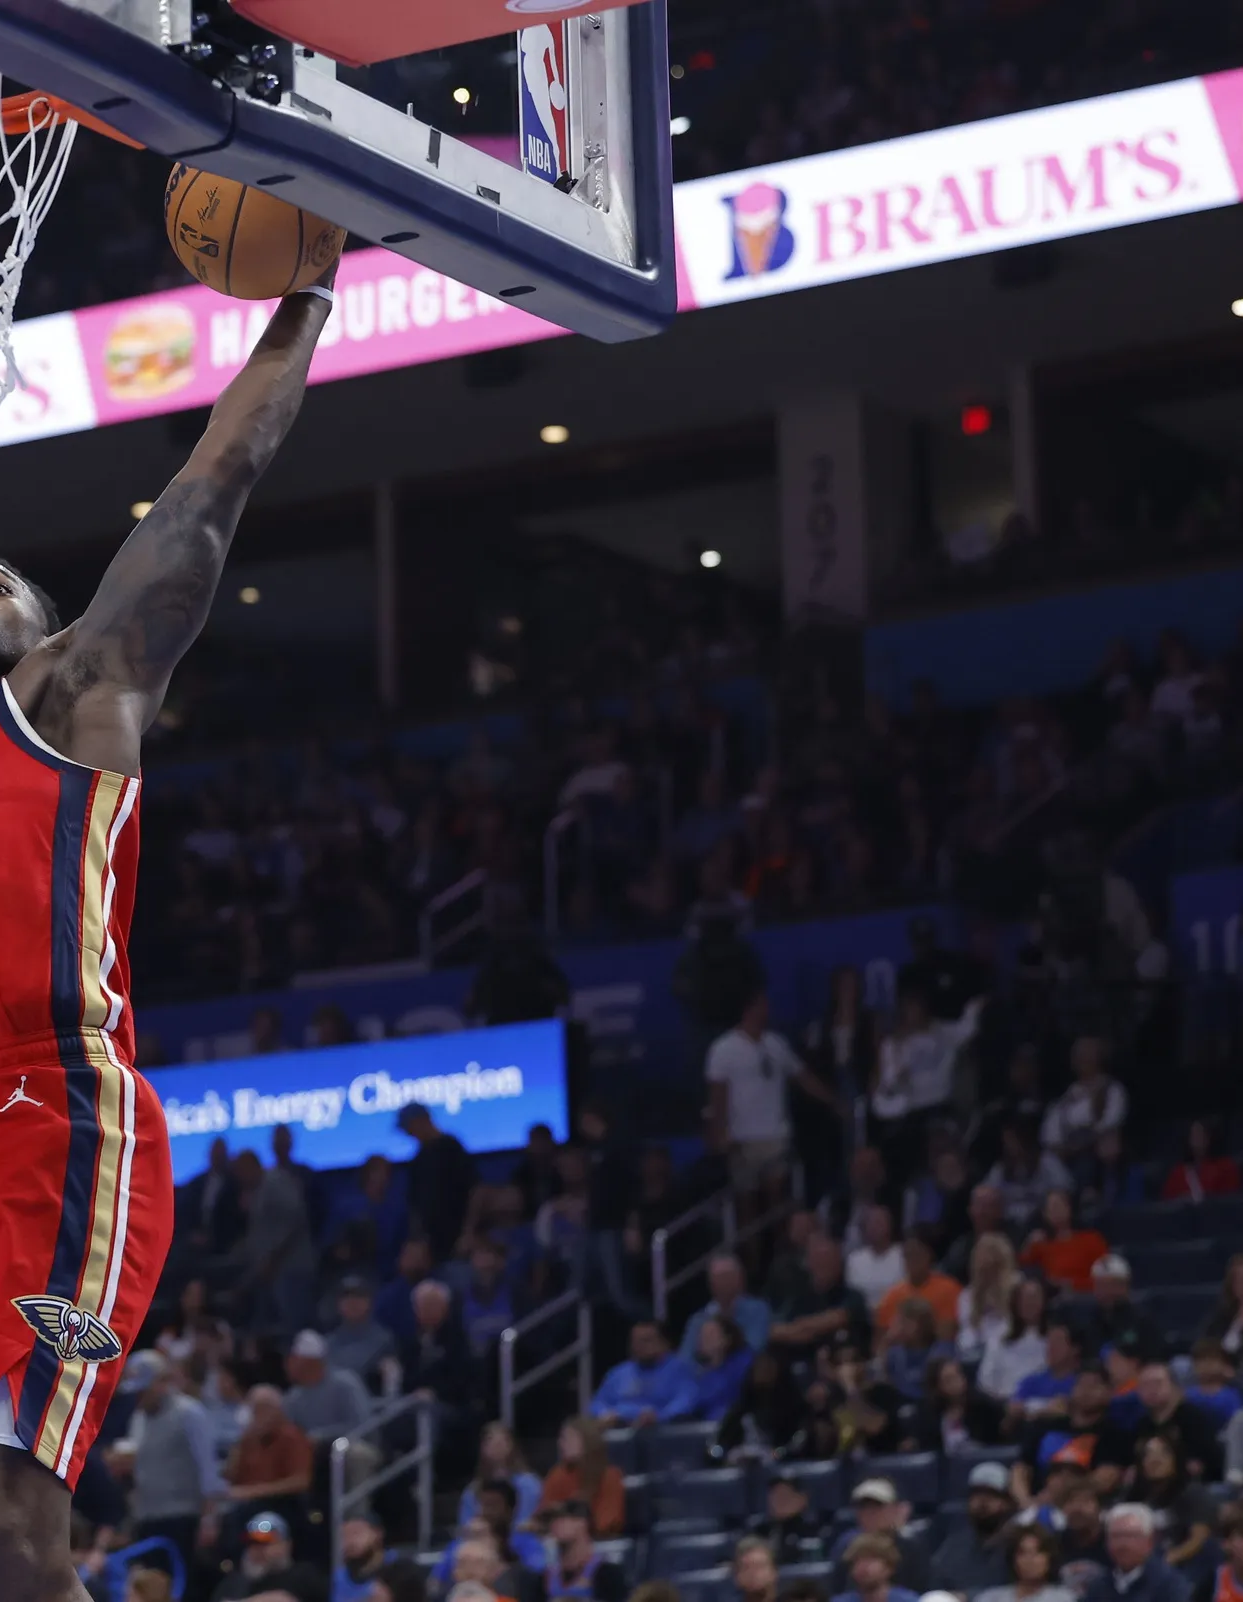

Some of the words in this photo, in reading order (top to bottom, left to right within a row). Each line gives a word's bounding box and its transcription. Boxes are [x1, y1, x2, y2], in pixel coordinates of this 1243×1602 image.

[527, 134, 552, 174] NBA
[812, 129, 1183, 264] BRAUM'S
[209, 269, 509, 369] HABURGE
[233, 1087, 346, 1131] Energy
[348, 1062, 523, 1114] Champion
